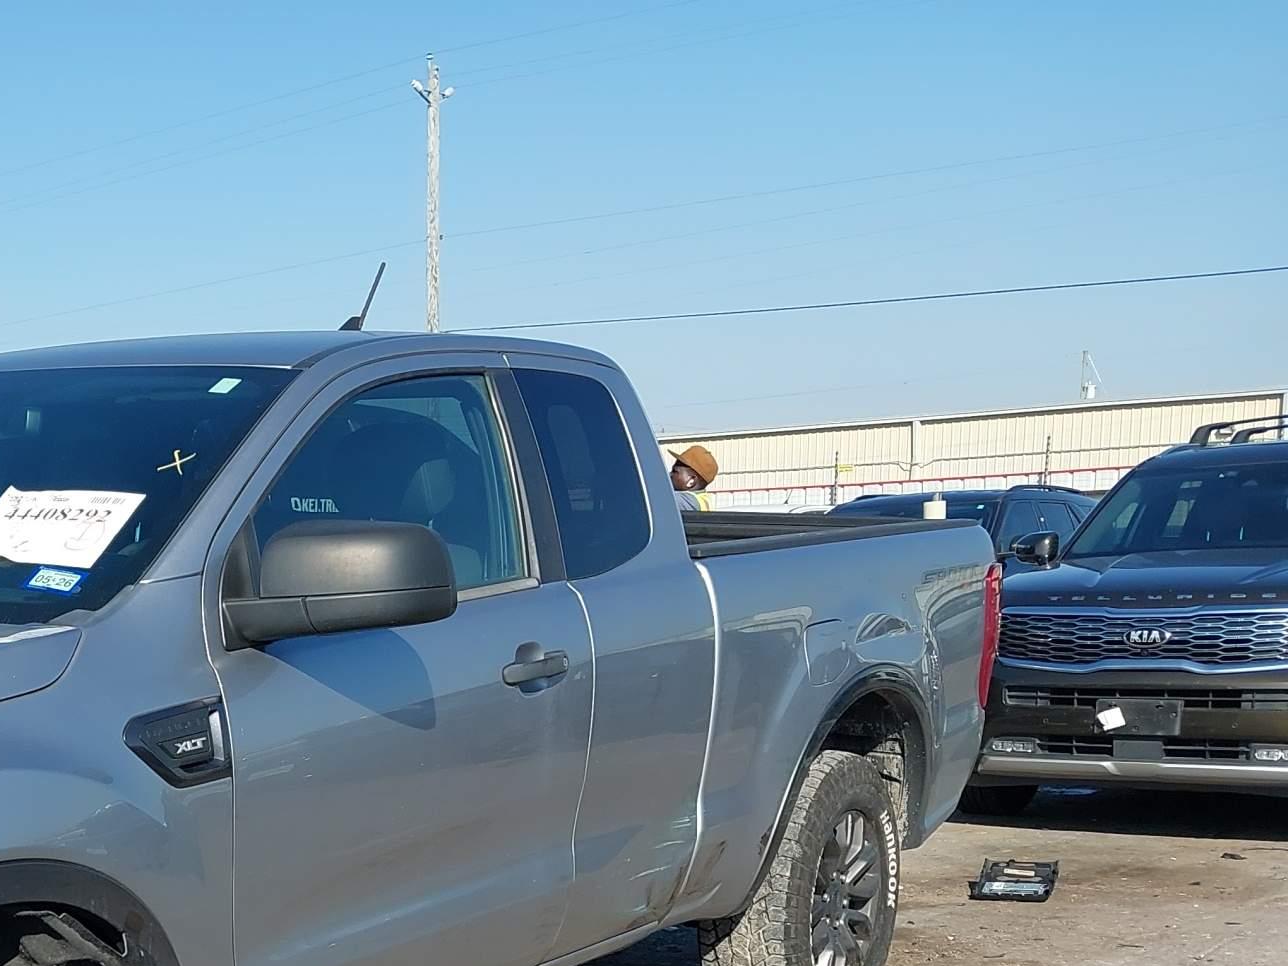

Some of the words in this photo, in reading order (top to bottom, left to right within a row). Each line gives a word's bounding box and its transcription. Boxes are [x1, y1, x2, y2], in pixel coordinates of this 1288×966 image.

[4, 507, 112, 523] 44408292
[1129, 629, 1162, 644] KIA
[174, 736, 207, 755] XLT
